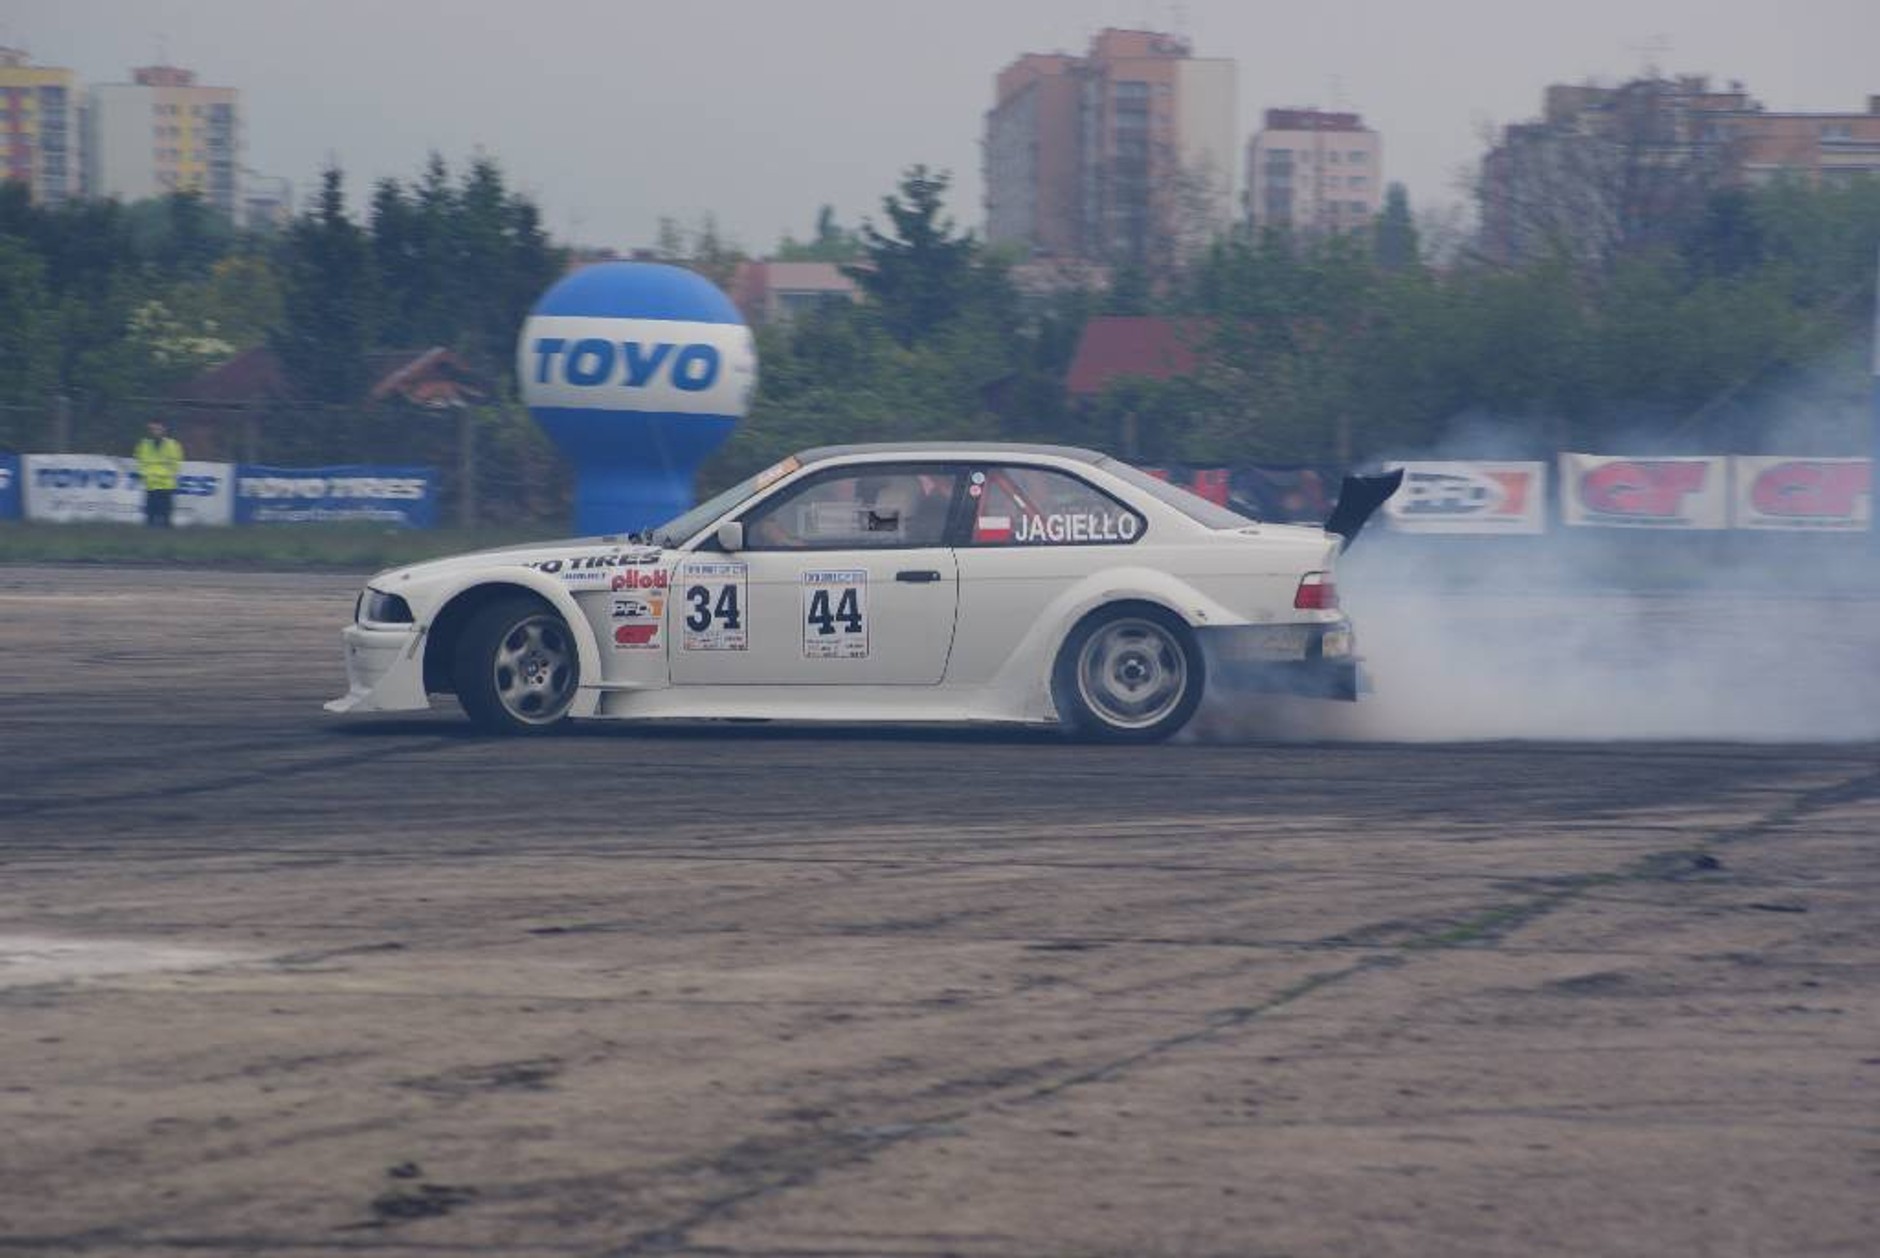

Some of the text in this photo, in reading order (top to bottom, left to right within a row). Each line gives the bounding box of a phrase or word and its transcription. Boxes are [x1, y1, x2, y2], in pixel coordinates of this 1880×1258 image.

[535, 338, 720, 392] TOYO
[239, 477, 427, 499] TOYO TIRES
[568, 549, 663, 570] TIRES
[686, 584, 741, 632] 34
[808, 588, 863, 635] 44
